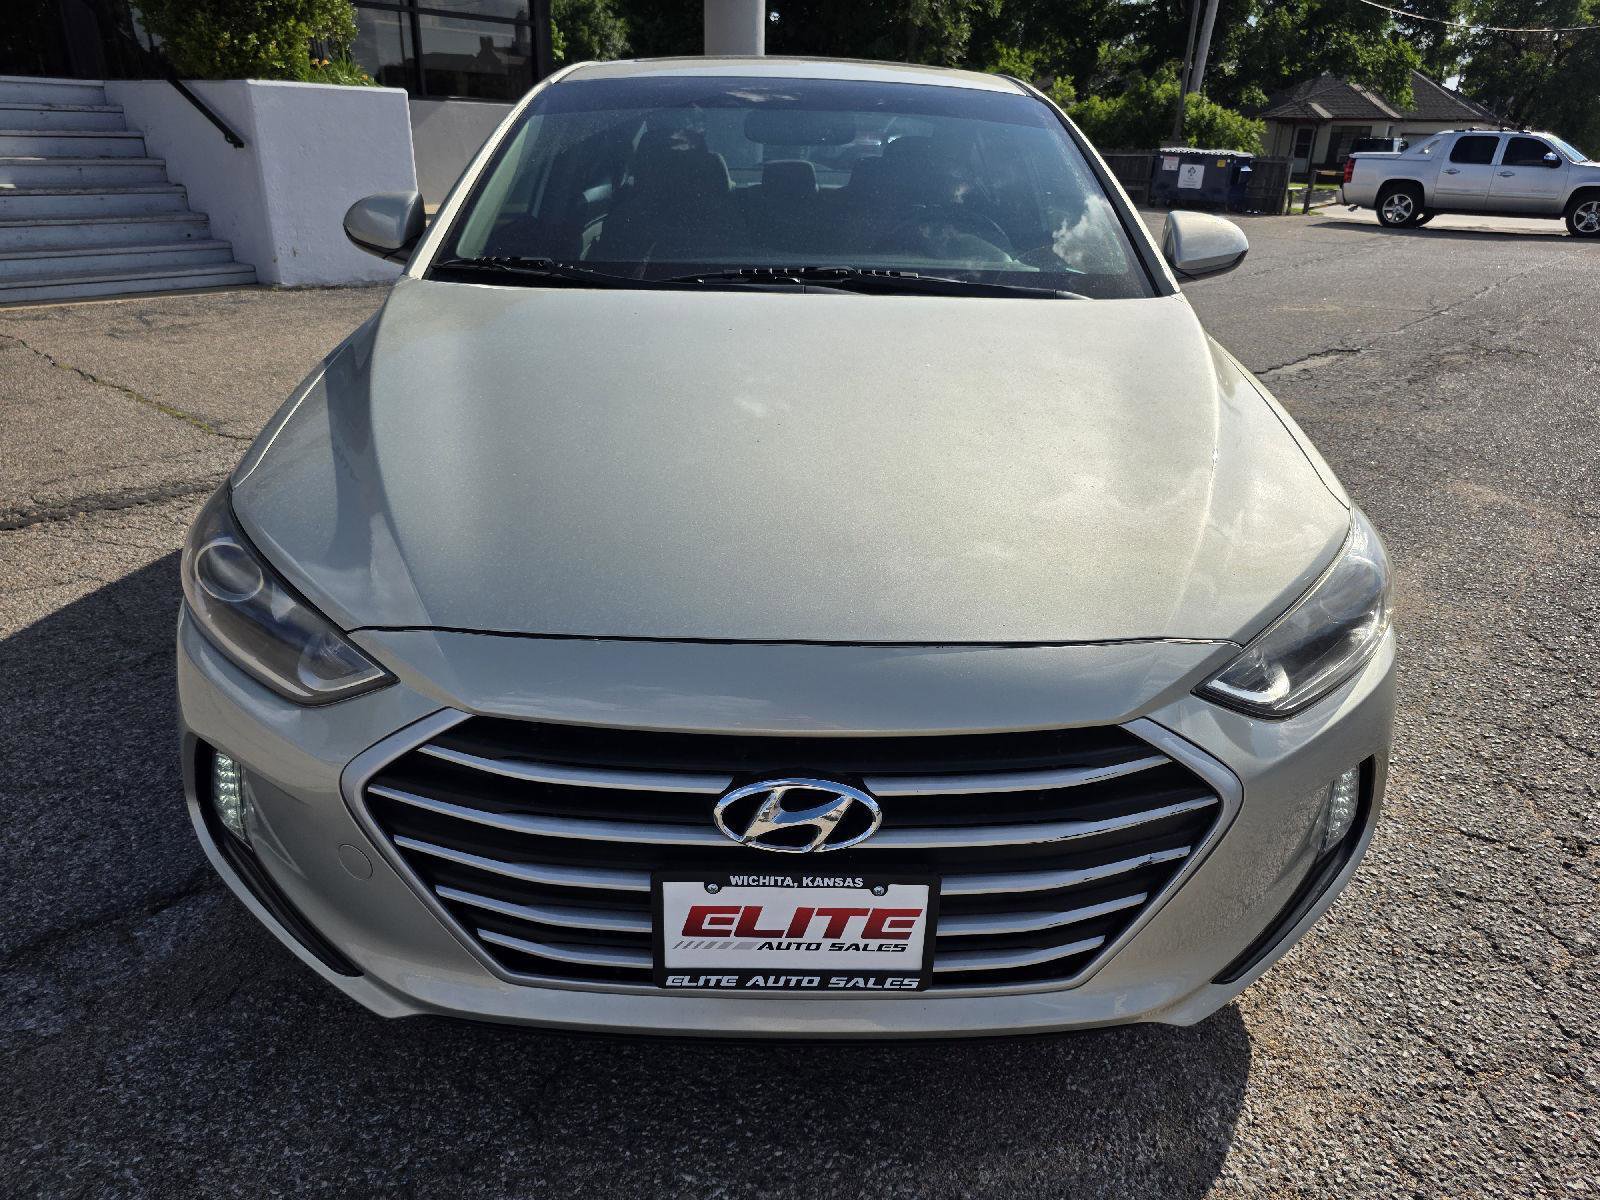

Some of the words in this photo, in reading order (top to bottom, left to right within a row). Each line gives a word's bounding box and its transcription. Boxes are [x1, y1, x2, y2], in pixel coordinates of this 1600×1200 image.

[730, 875, 798, 888] WICHITA,
[802, 876, 864, 888] KANSAS
[681, 905, 923, 940] ELITE
[757, 941, 822, 951] AUTO
[828, 942, 909, 952] SALES
[665, 975, 739, 987] ELITE
[745, 975, 822, 988] AUTO
[828, 977, 921, 989] SALES
